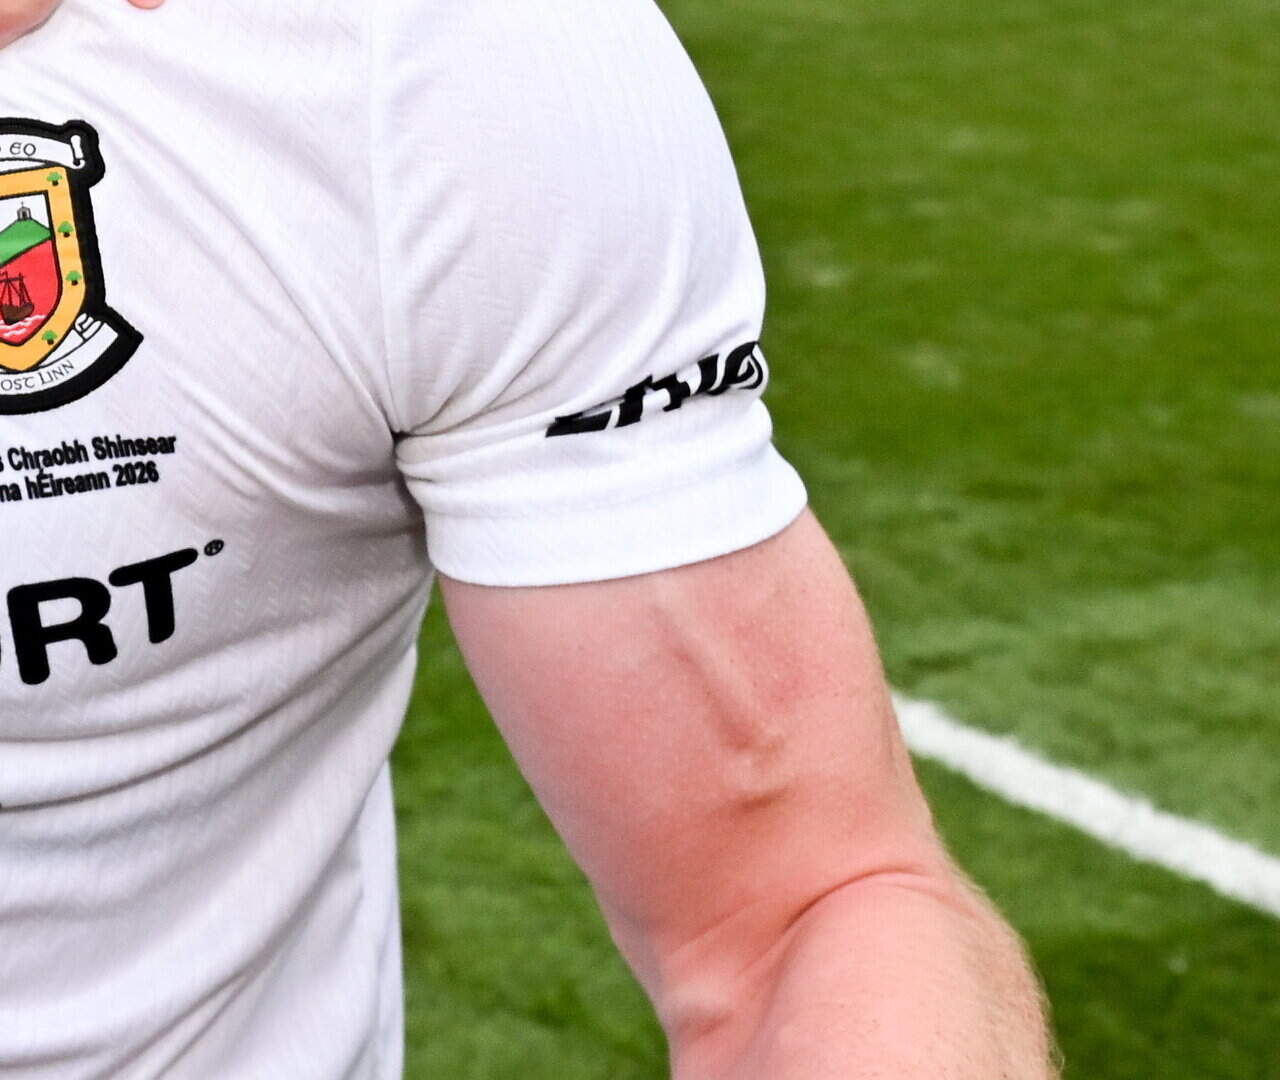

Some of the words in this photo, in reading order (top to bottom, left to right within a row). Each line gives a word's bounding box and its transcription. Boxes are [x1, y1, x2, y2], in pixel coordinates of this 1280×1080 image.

[7, 440, 90, 471] Chraobh
[91, 434, 177, 461] Shinsear
[112, 460, 160, 488] 2026
